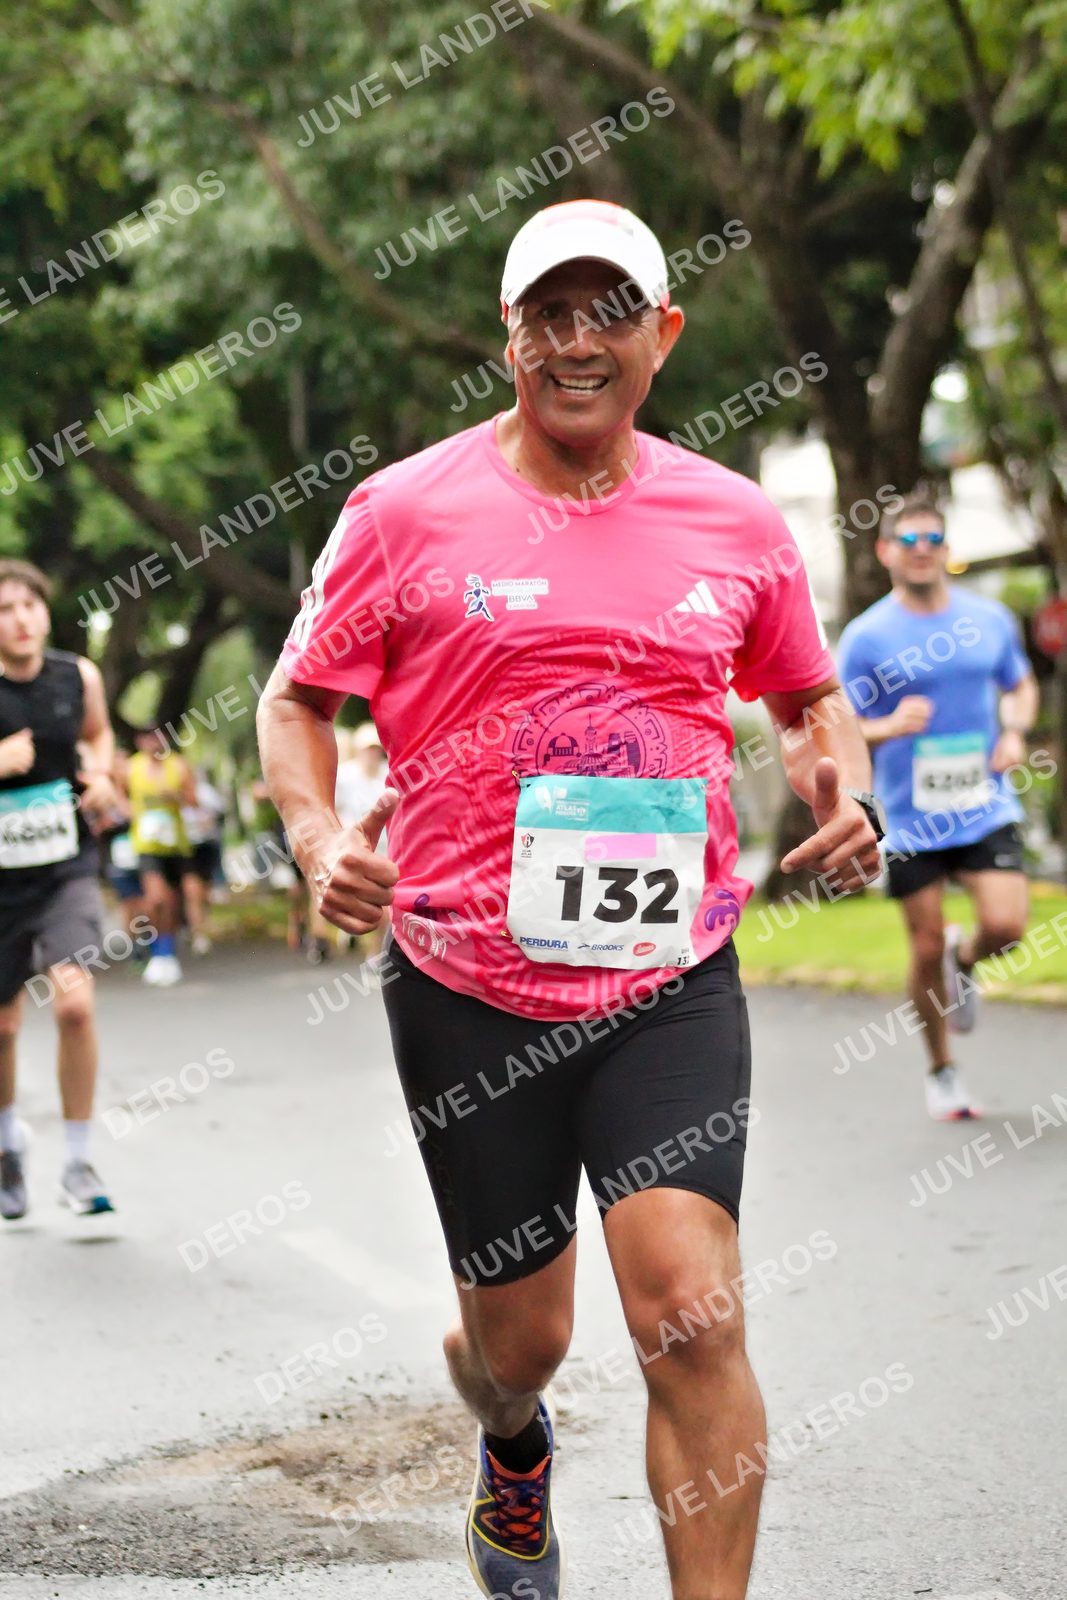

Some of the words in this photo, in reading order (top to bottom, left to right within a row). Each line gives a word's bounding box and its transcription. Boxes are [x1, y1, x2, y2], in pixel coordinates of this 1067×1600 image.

[508, 594, 533, 603] BBVA
[555, 865, 680, 924] 132
[519, 936, 569, 950] PERDURA
[591, 943, 625, 951] BROOKS
